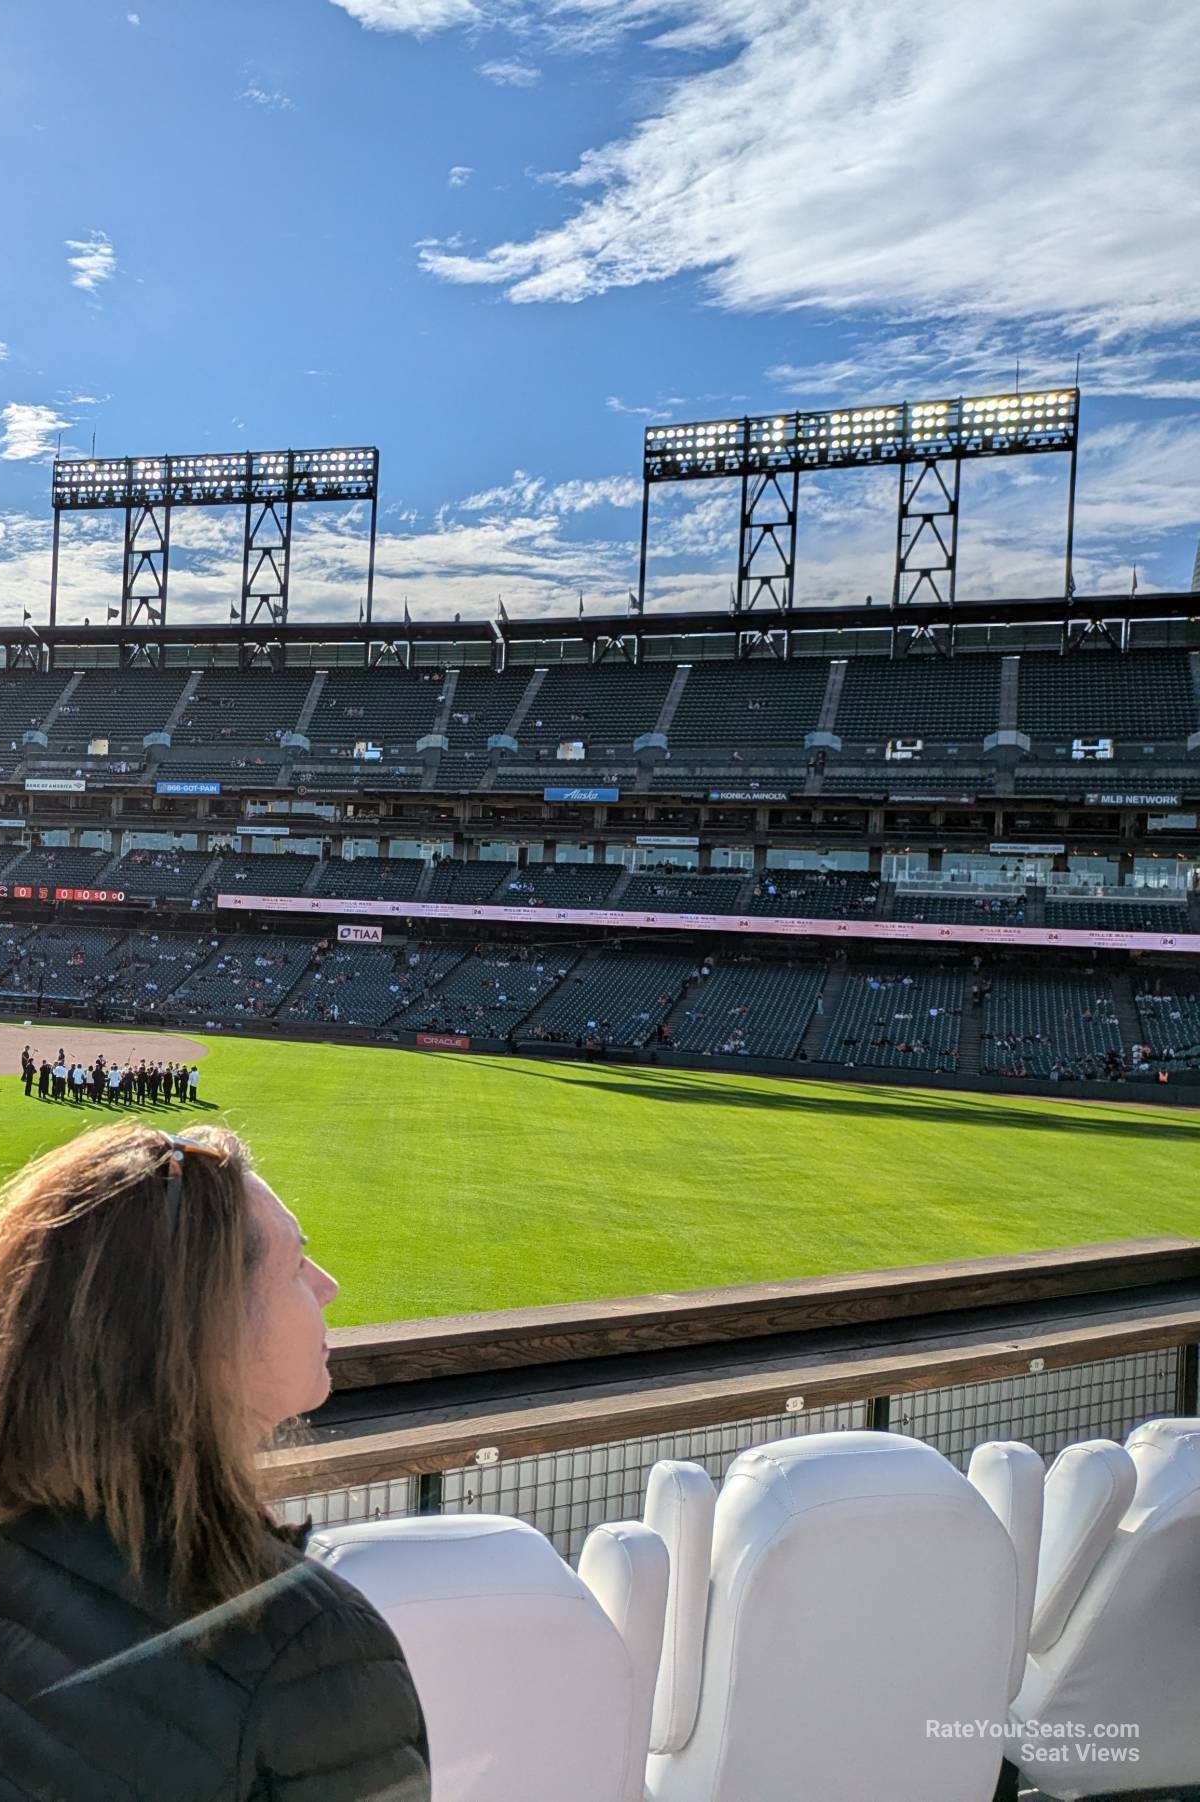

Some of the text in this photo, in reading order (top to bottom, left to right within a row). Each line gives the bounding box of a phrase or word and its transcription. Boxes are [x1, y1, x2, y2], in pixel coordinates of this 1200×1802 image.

[563, 789, 599, 800] Alaska
[720, 792, 787, 800] KONICA MINOLTA
[1101, 795, 1178, 805] MLB NETWORK
[20, 887, 26, 896] 0
[61, 888, 67, 898] 0
[352, 928, 379, 940] TIAA
[424, 1037, 462, 1046] ORACLE
